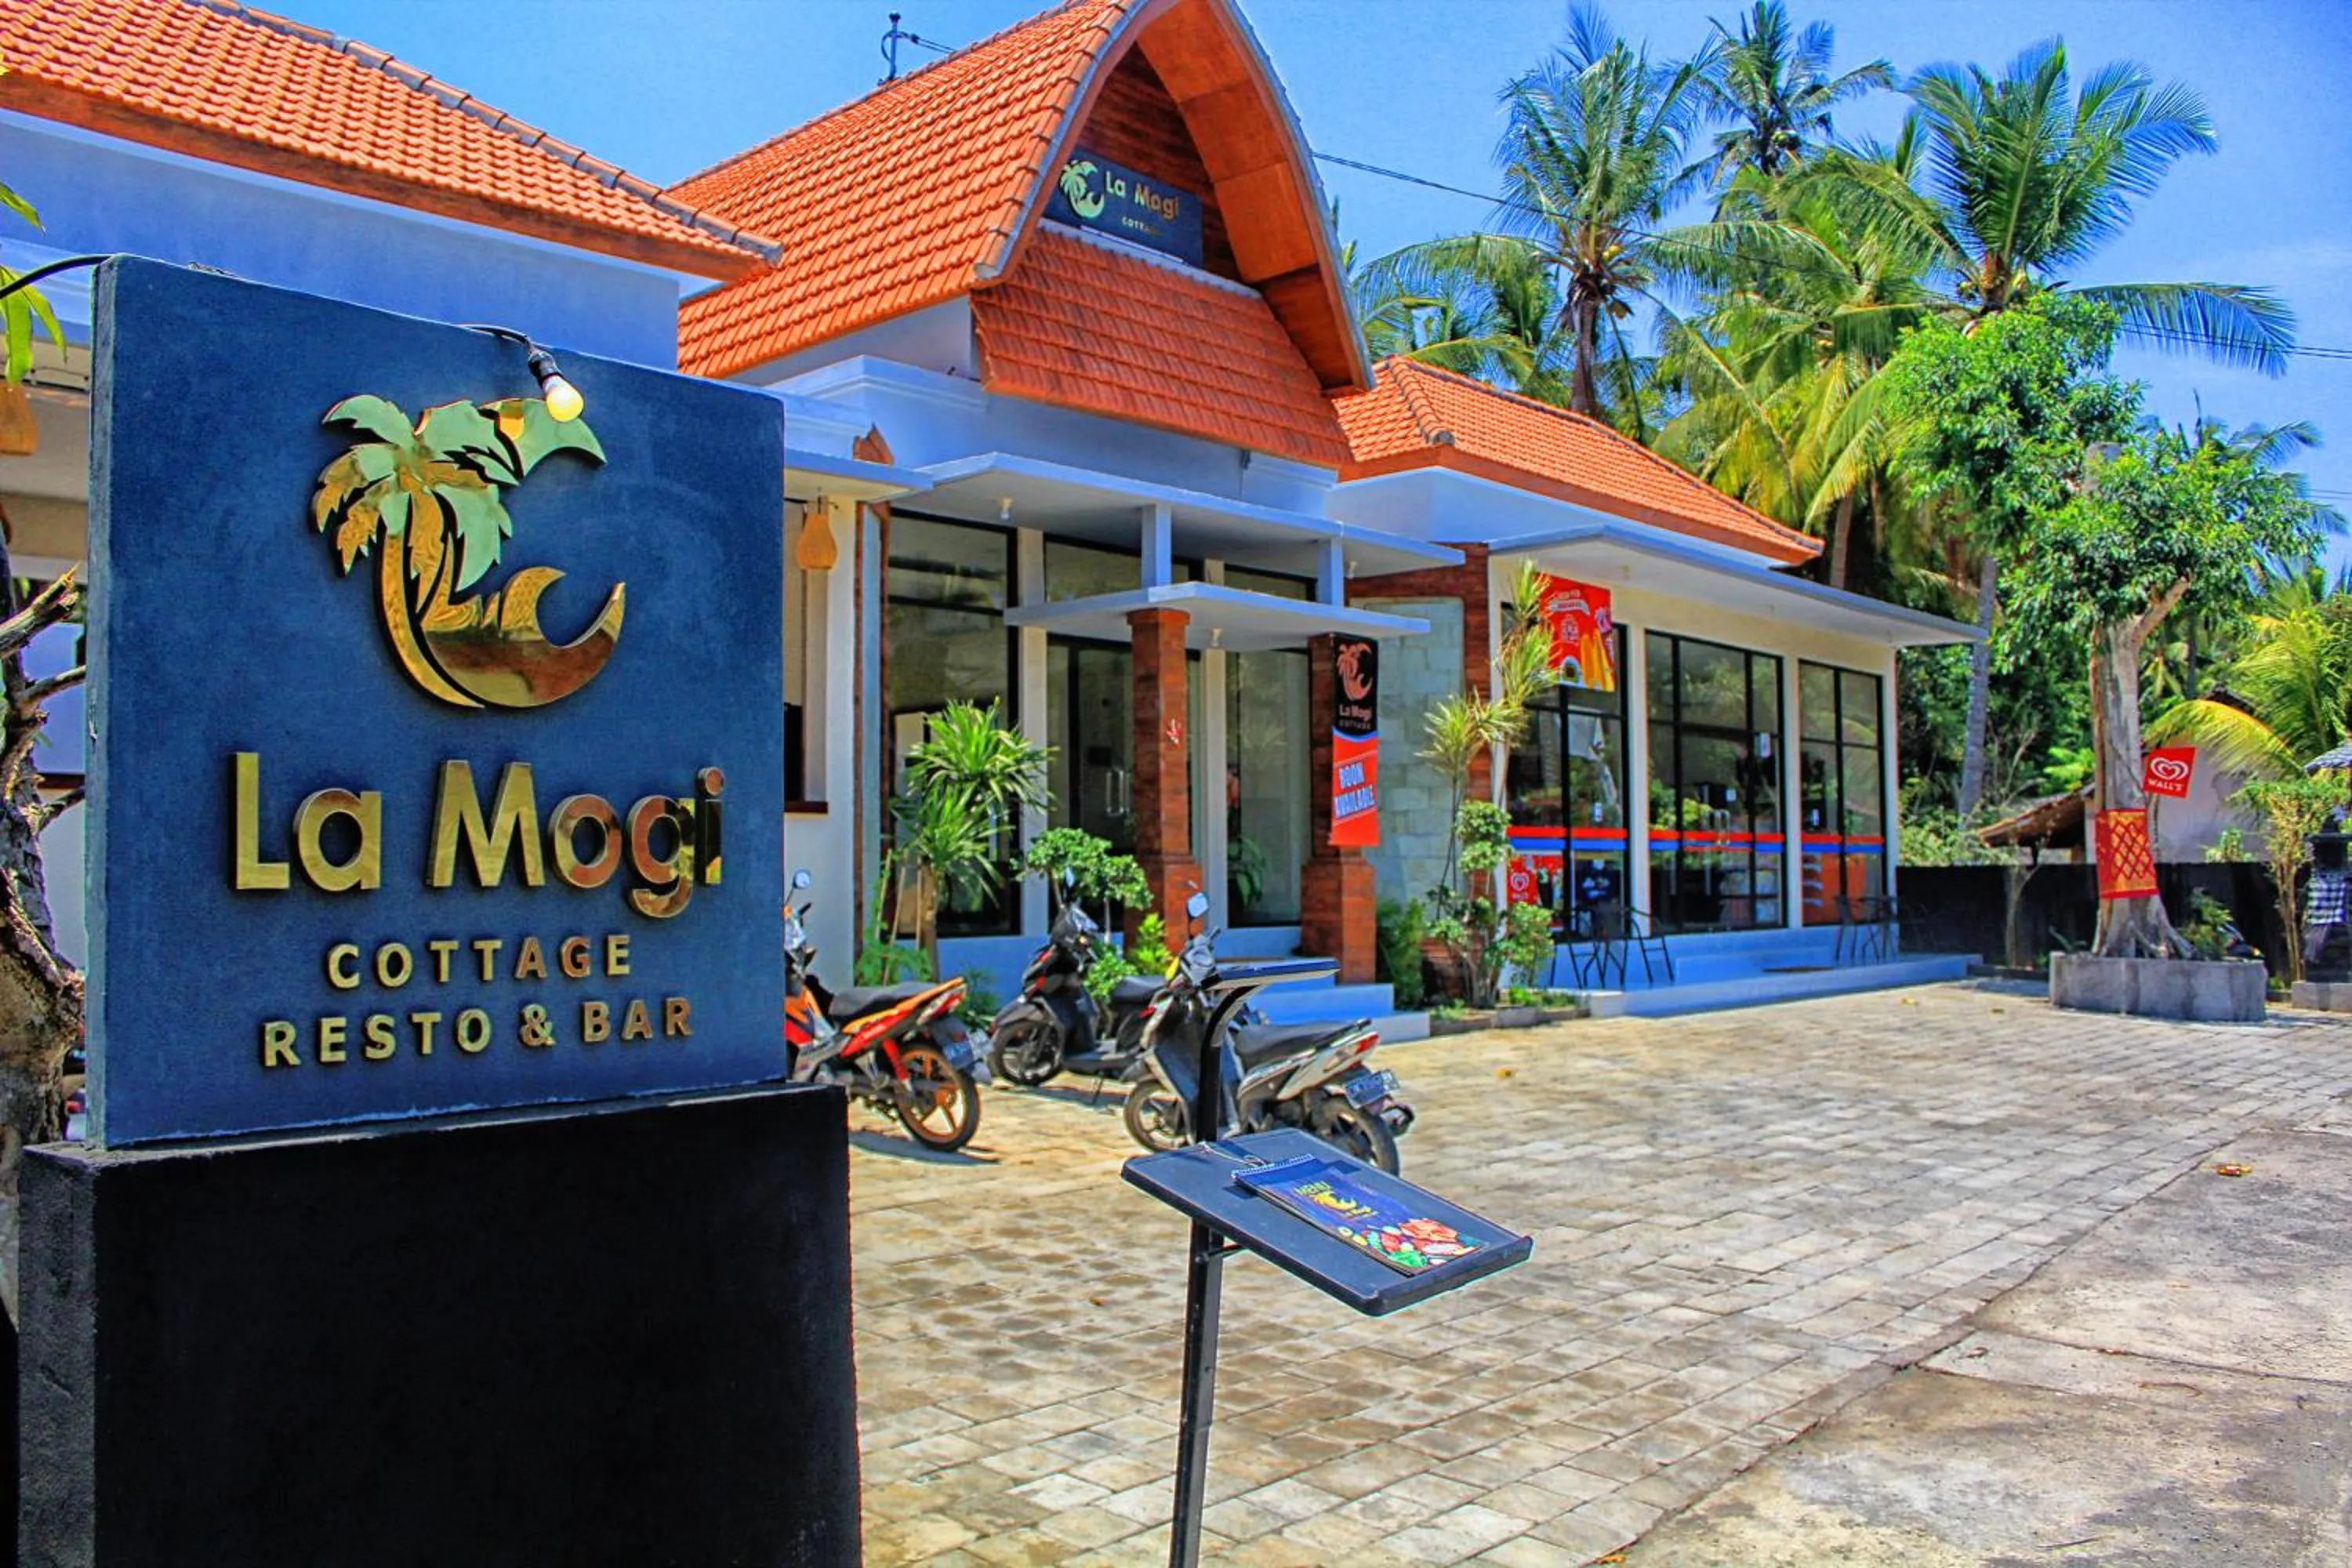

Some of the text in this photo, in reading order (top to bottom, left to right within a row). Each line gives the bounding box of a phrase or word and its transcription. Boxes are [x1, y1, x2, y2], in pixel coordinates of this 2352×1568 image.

[1105, 170, 1179, 220] La Mogi
[234, 752, 726, 918] La Mogi
[327, 934, 632, 989] COTTAGE
[263, 996, 693, 1068] RESTO & BAR
